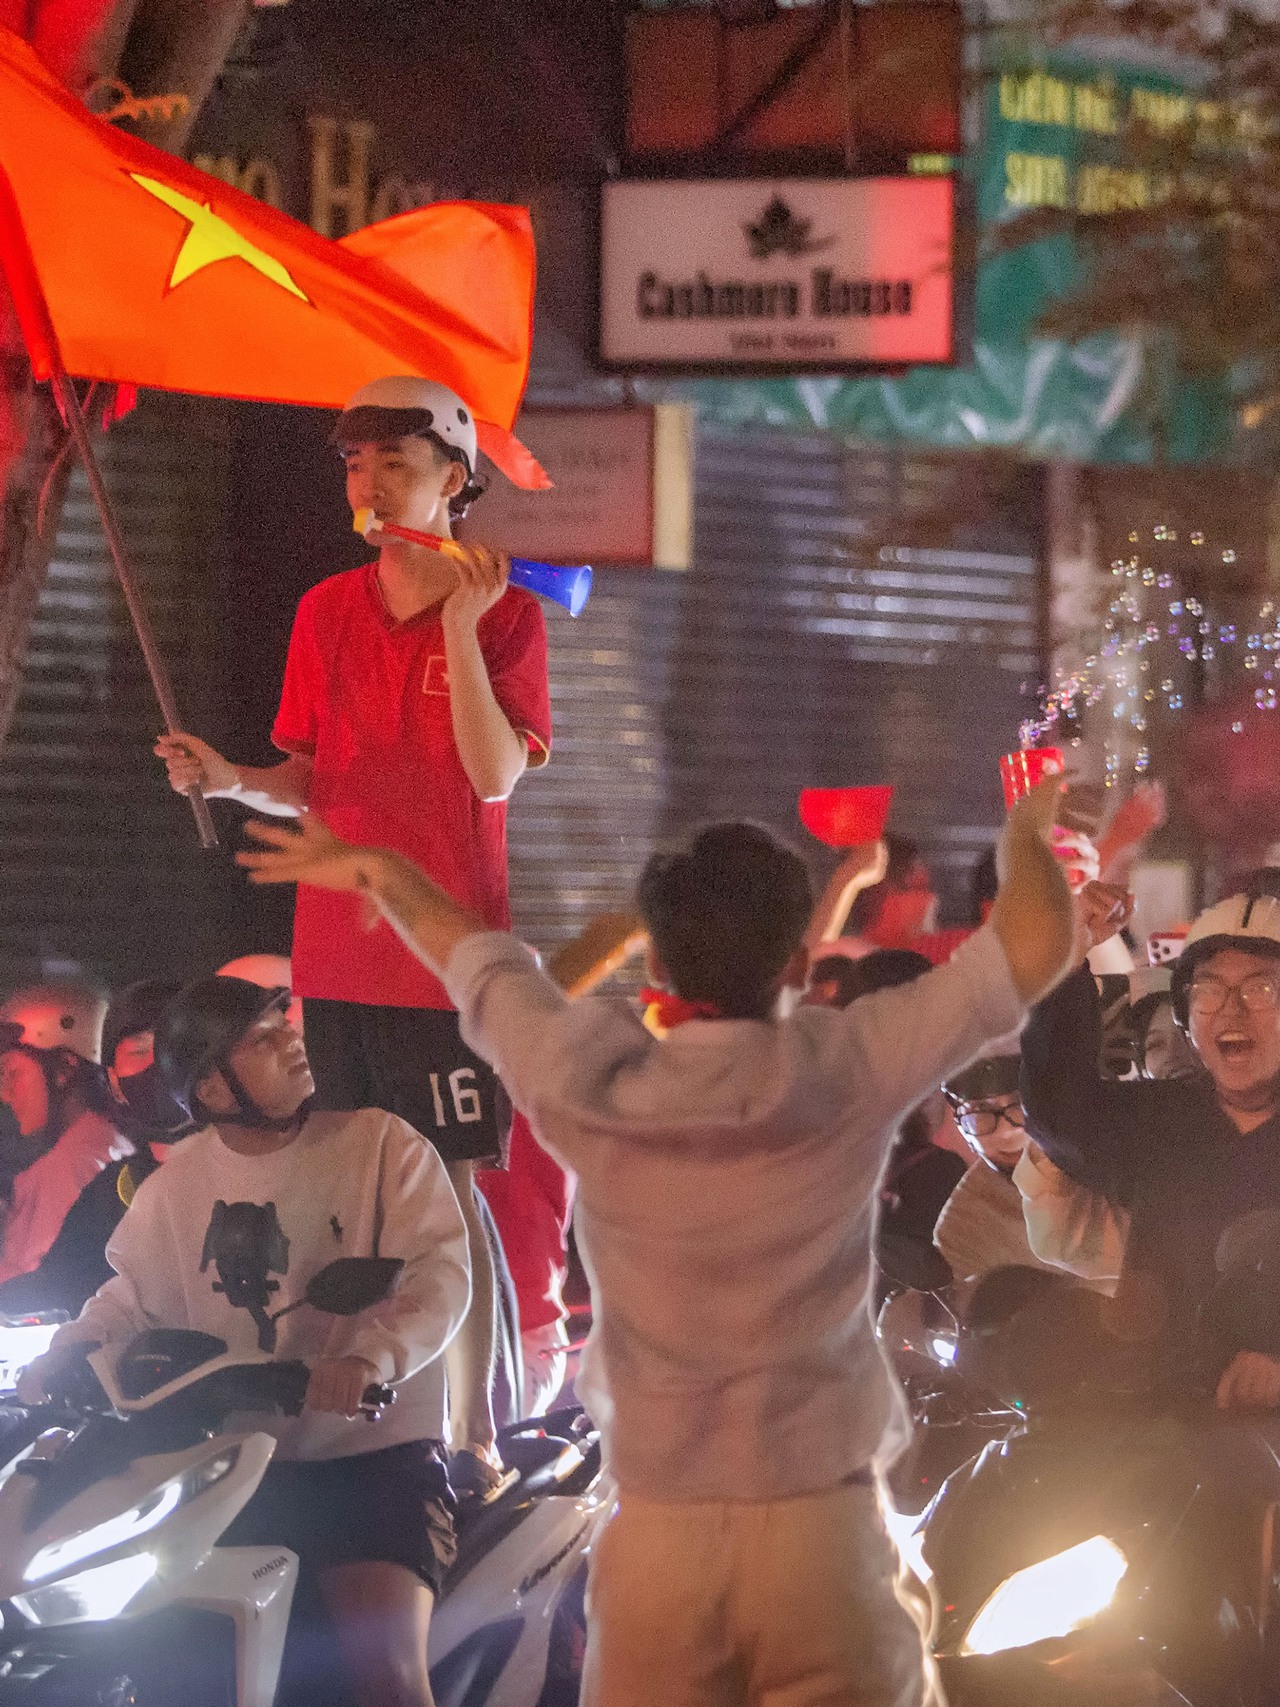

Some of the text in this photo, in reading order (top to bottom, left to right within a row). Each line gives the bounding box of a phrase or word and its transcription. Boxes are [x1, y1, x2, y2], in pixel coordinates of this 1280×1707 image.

[812, 267, 912, 317] House
[429, 1067, 482, 1127] 16
[252, 1556, 288, 1580] HONDA
